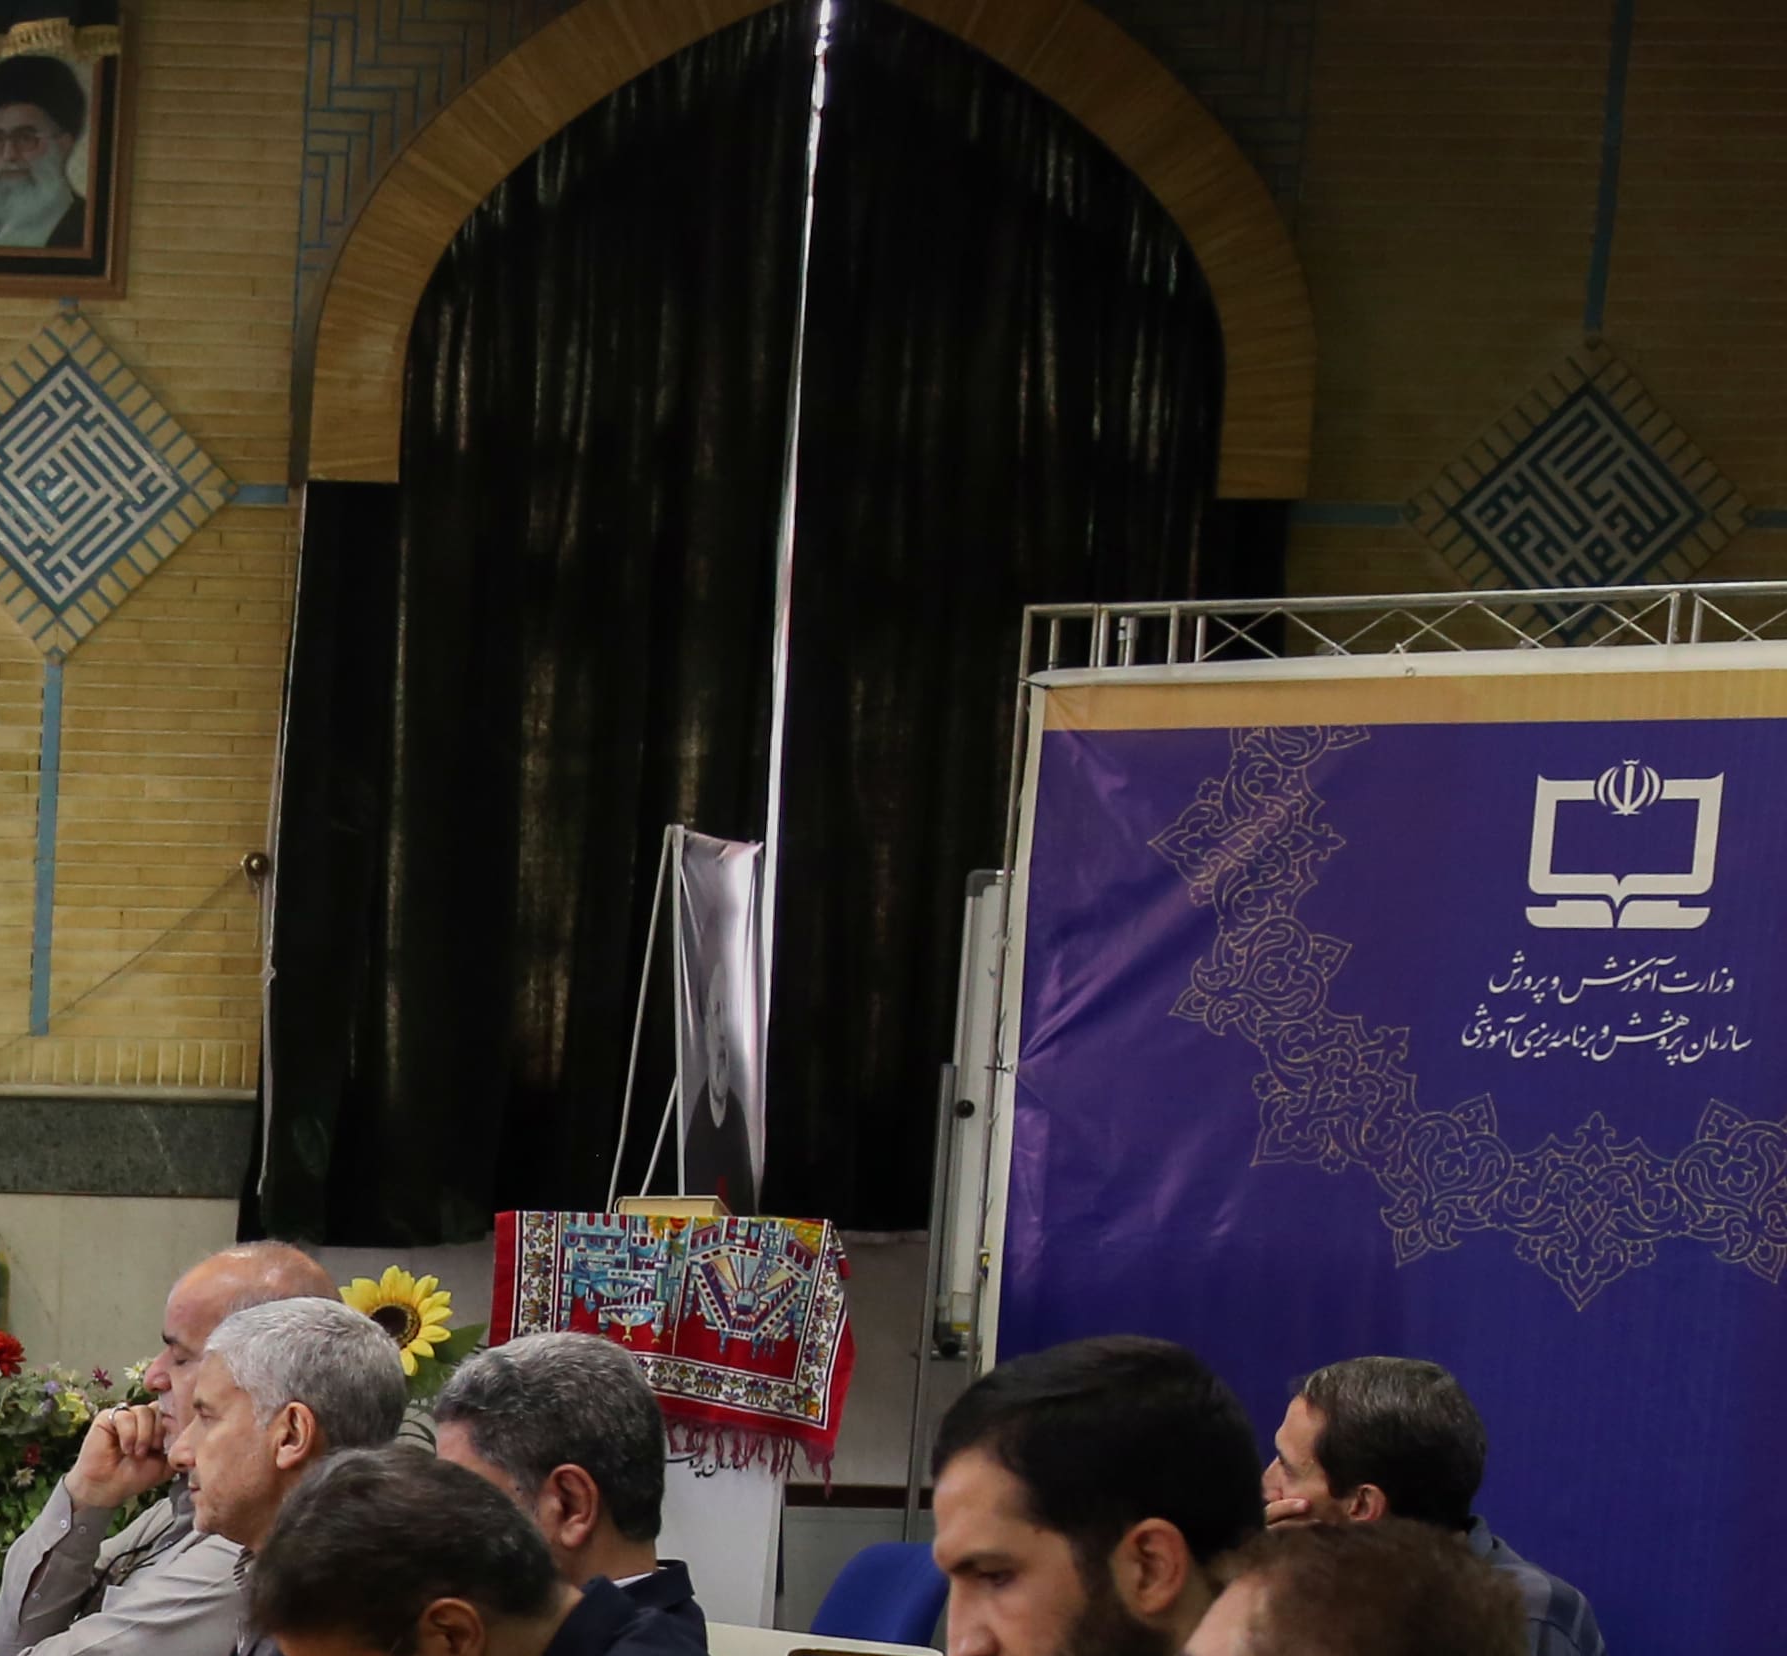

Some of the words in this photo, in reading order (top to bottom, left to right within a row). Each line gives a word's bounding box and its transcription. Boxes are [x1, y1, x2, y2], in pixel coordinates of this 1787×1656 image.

[1488, 950, 1548, 1004] پرورش
[1551, 976, 1560, 991] و
[1558, 955, 1677, 1004] آموزش
[1659, 966, 1735, 993] وزارت
[1460, 1003, 1527, 1049] آموزشی
[1591, 1009, 1690, 1066] پژوهش
[1680, 1024, 1752, 1063] سازمان
